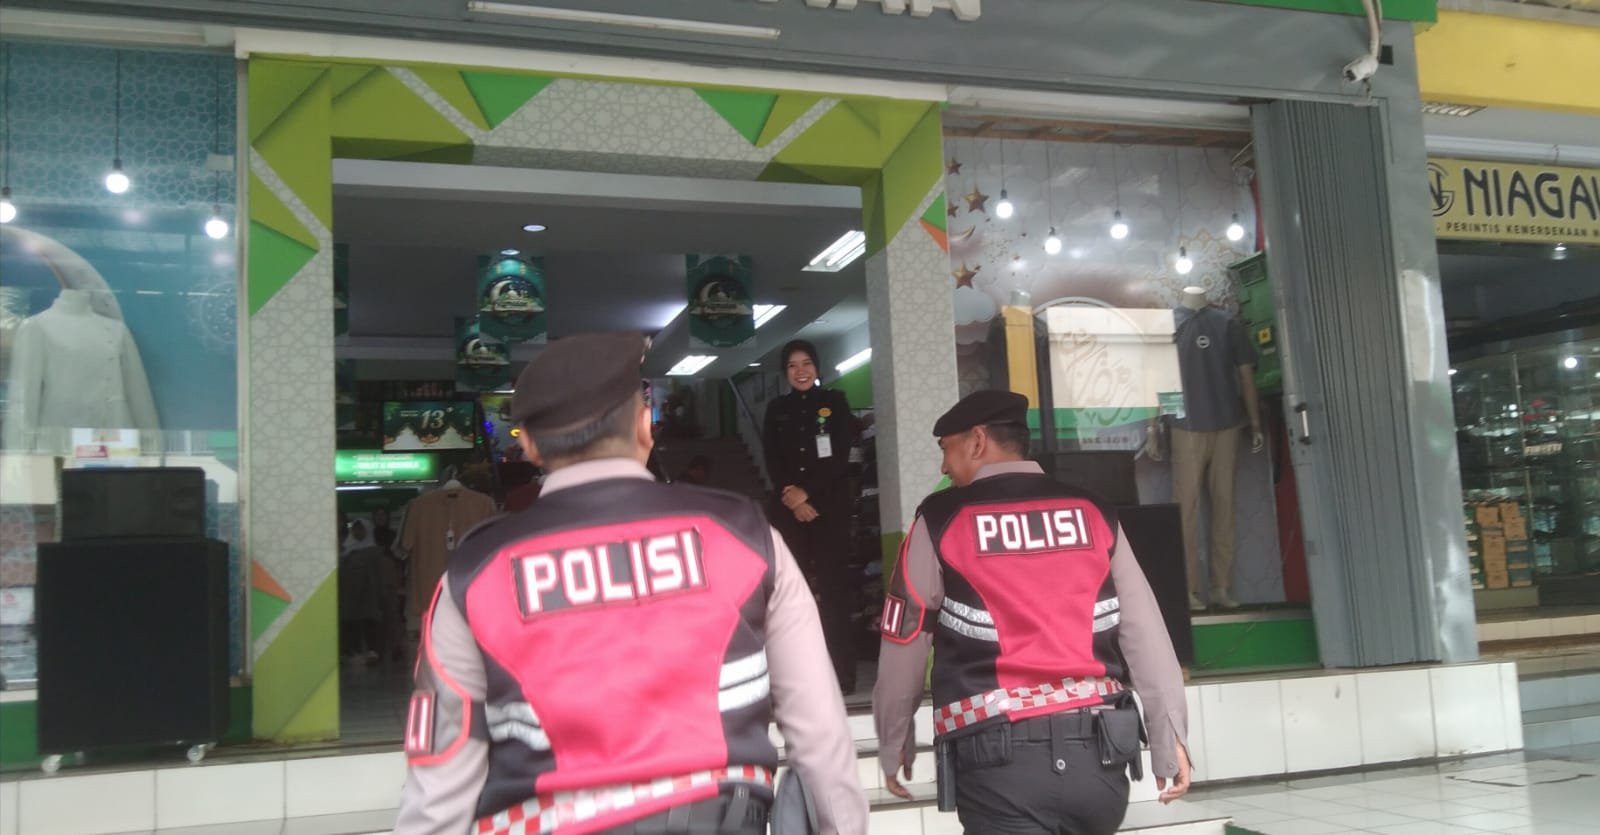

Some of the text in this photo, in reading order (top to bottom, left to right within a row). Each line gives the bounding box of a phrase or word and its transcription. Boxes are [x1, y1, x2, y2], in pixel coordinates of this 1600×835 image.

[1446, 222, 1500, 233] PERINTIS
[421, 409, 445, 429] 13
[975, 508, 1088, 551] POLISI
[522, 531, 701, 613] POLISI
